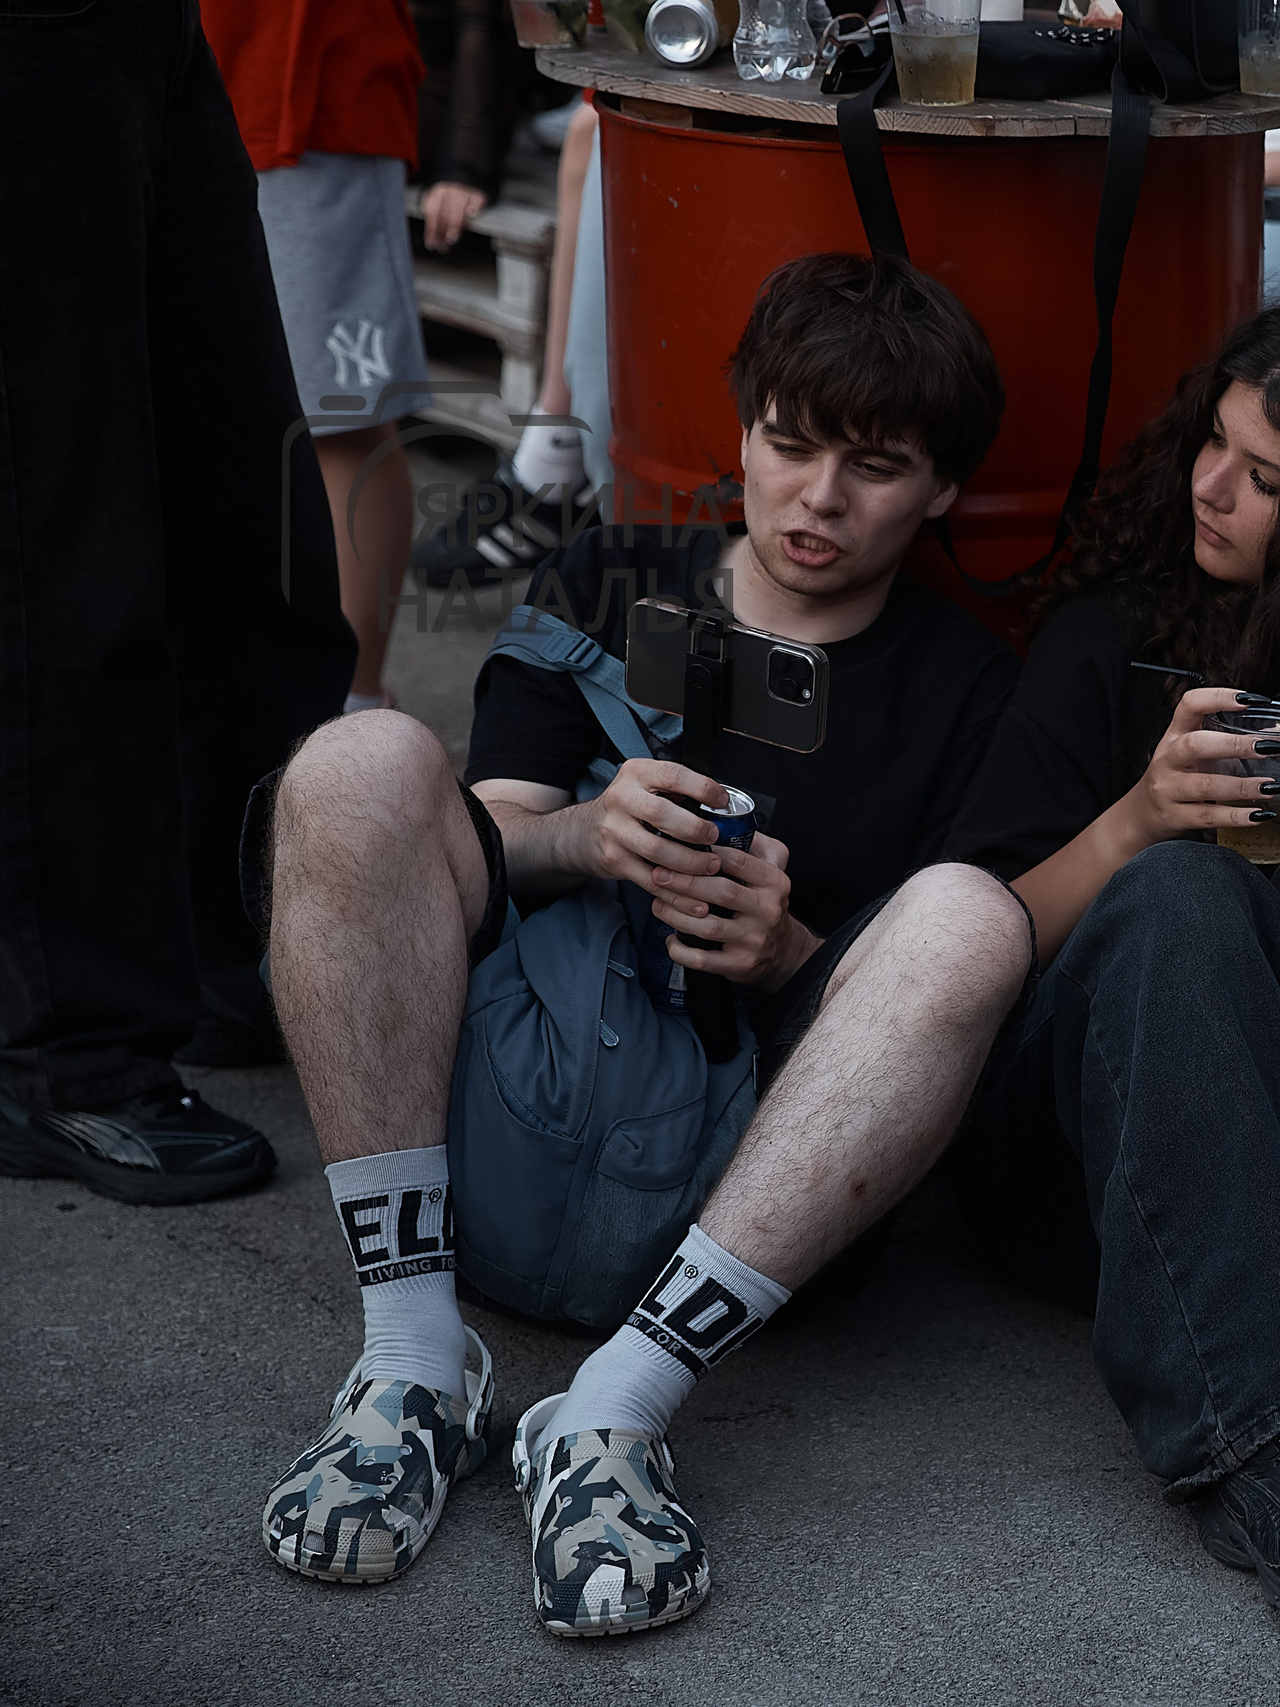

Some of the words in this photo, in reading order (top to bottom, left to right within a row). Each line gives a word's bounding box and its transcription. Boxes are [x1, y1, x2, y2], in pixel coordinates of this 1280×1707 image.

[325, 319, 391, 389] NY
[368, 1259, 433, 1284] LIVING
[440, 1256, 456, 1270] FO
[644, 1325, 683, 1355] FOR
